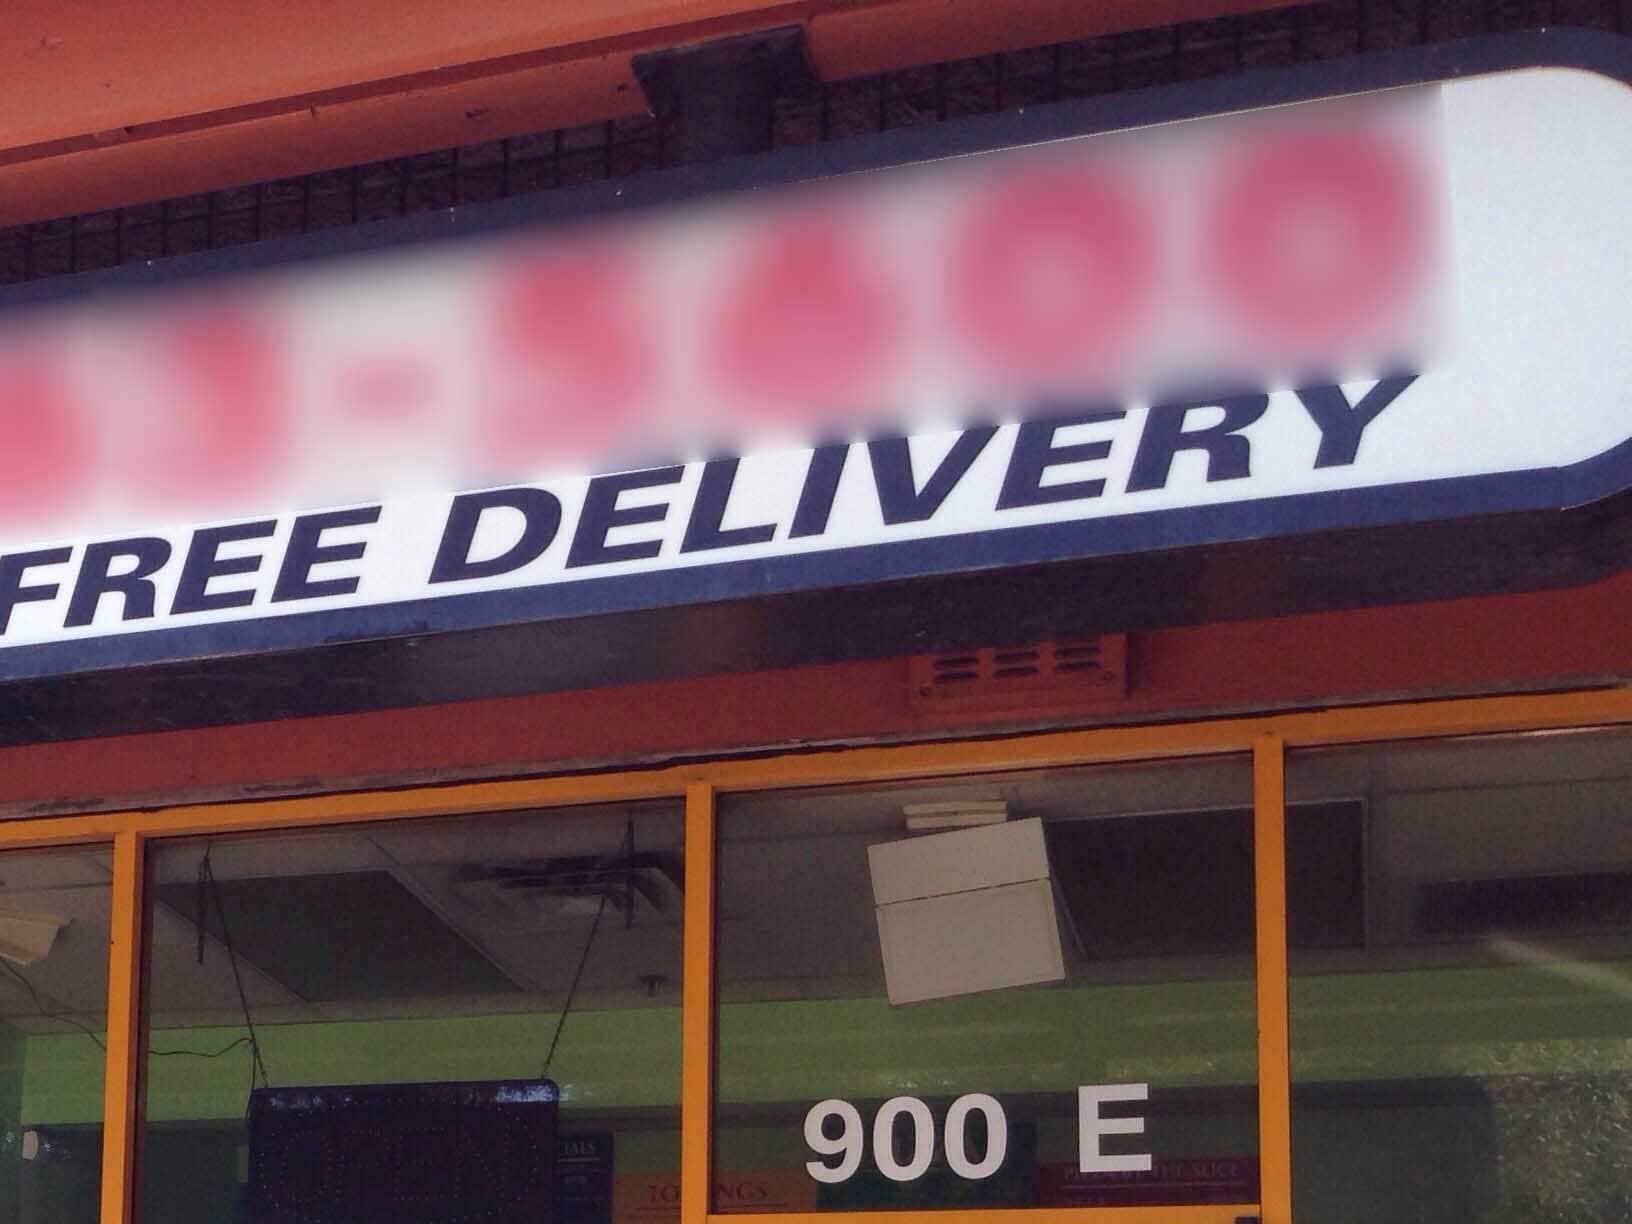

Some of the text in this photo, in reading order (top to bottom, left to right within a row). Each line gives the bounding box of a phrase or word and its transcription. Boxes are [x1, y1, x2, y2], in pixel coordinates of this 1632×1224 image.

[427, 372, 1422, 586] DELIVERY
[803, 1083, 1153, 1184] 900 E
